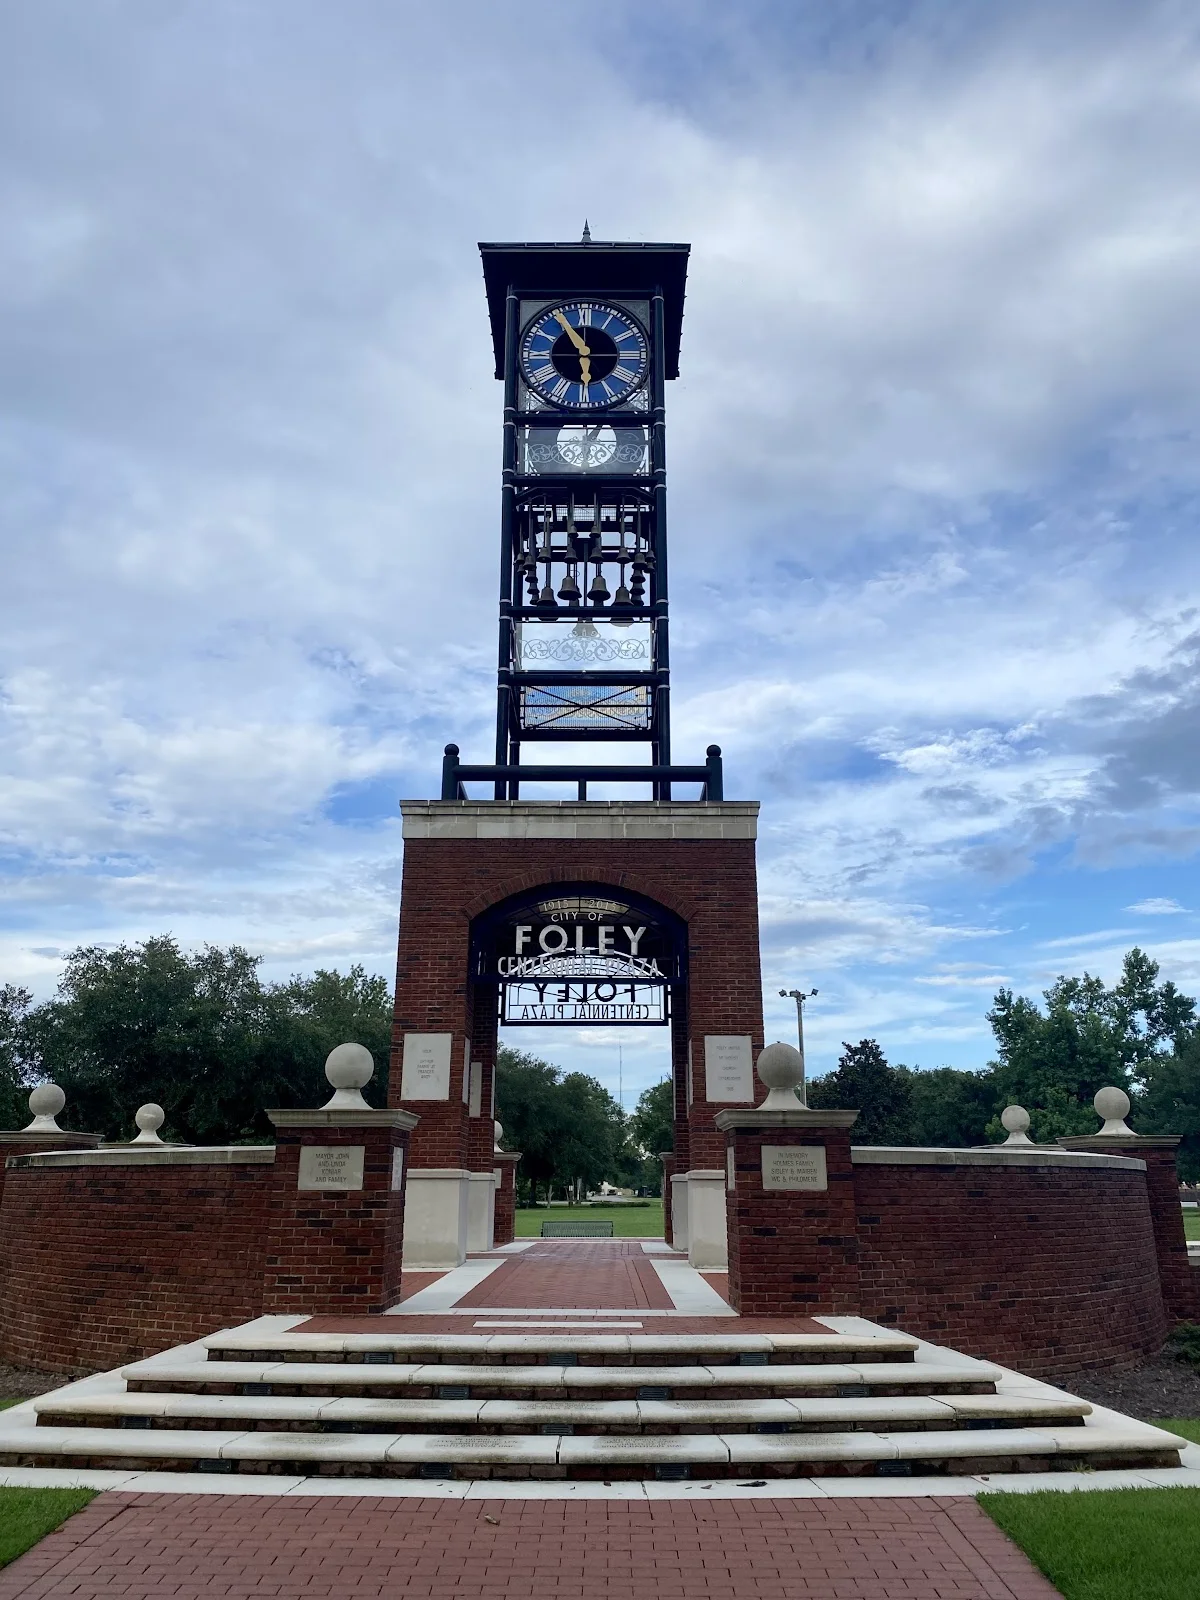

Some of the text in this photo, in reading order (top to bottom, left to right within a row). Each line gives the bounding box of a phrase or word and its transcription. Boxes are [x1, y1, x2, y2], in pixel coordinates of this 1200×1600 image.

[543, 900, 617, 911] 1915 2015
[551, 912, 604, 922] CITY OF
[515, 925, 647, 955] FOLEY
[497, 956, 660, 977] CENTENNIAL PLAZA
